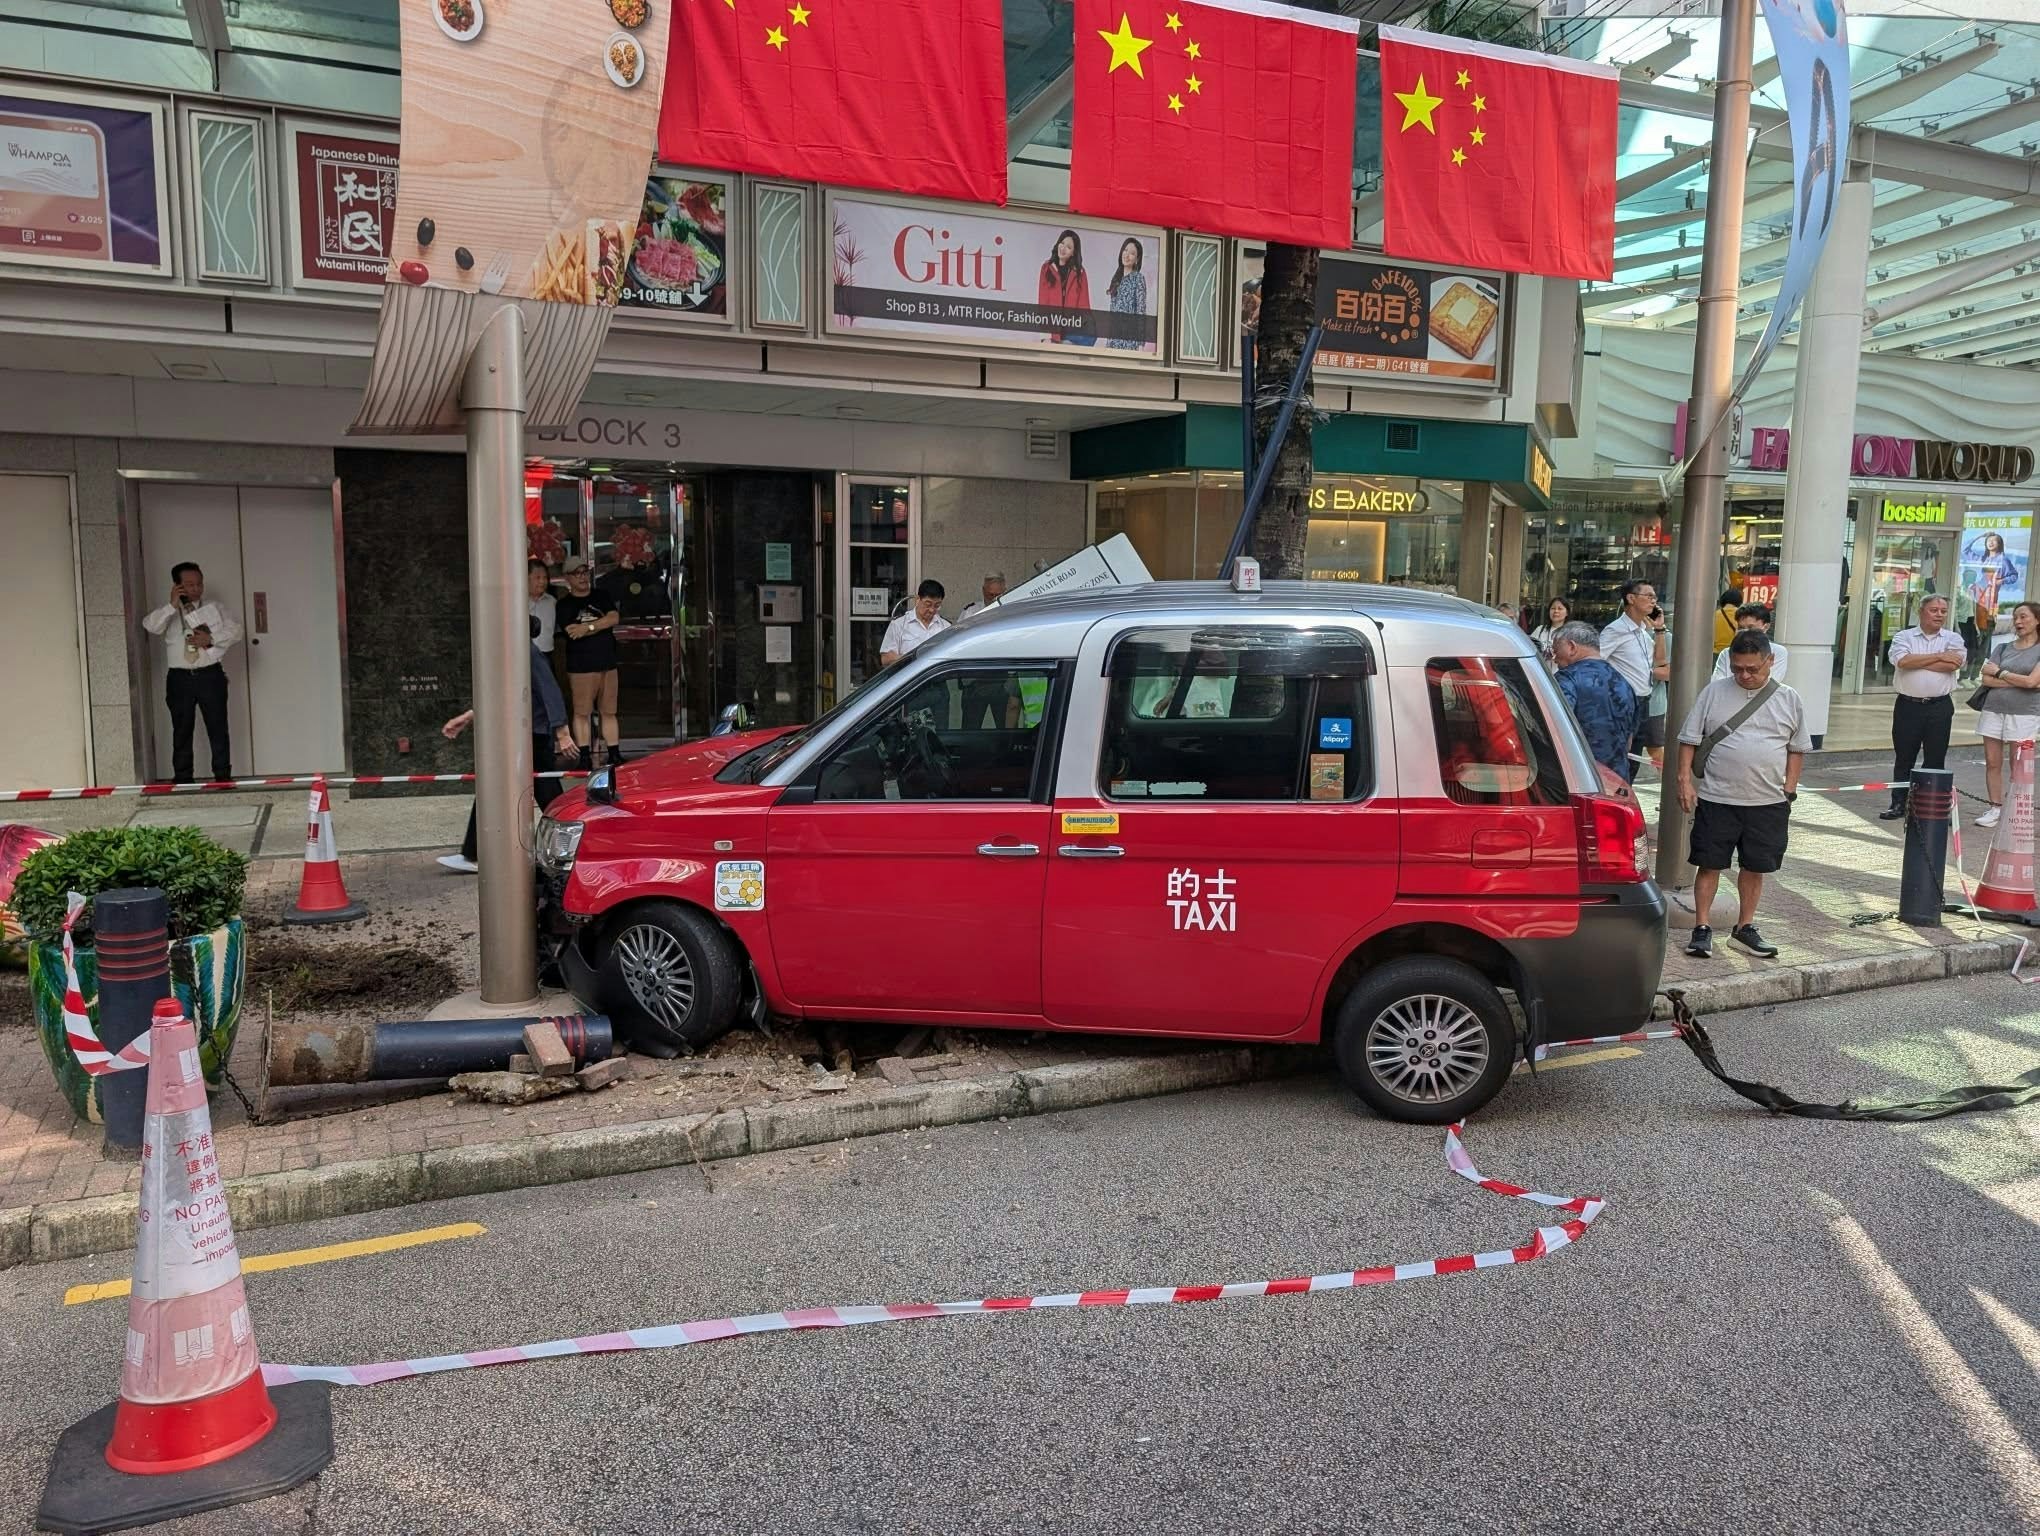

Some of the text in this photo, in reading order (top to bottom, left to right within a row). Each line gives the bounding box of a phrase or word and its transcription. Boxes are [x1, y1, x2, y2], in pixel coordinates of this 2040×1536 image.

[8, 148, 71, 163] WHAMPOA
[310, 145, 366, 161] Japanese
[380, 171, 395, 210] 居食屋
[334, 171, 384, 252] 和民
[325, 215, 339, 250] わたみ
[315, 257, 356, 272] Watami
[893, 224, 1007, 291] Gitti
[886, 298, 916, 316] Shop
[948, 303, 973, 318] MTR
[975, 306, 1005, 323] Floor,
[1008, 310, 1049, 325] Fashion
[1050, 314, 1082, 328] World
[1336, 288, 1407, 324] 百份百
[1320, 317, 1373, 335] Make it fresh
[664, 423, 681, 448] 3
[1914, 439, 2035, 484] WORLD
[1333, 490, 1417, 512] BAKERY
[1882, 499, 1947, 523] bossini
[1029, 567, 1077, 597] PRIVATE ROAD
[1089, 571, 1110, 587] ZONE
[1167, 867, 1237, 900] 的士
[1166, 900, 1236, 931] TAXI
[175, 1203, 201, 1221] NO
[192, 1228, 228, 1250] vehicle
